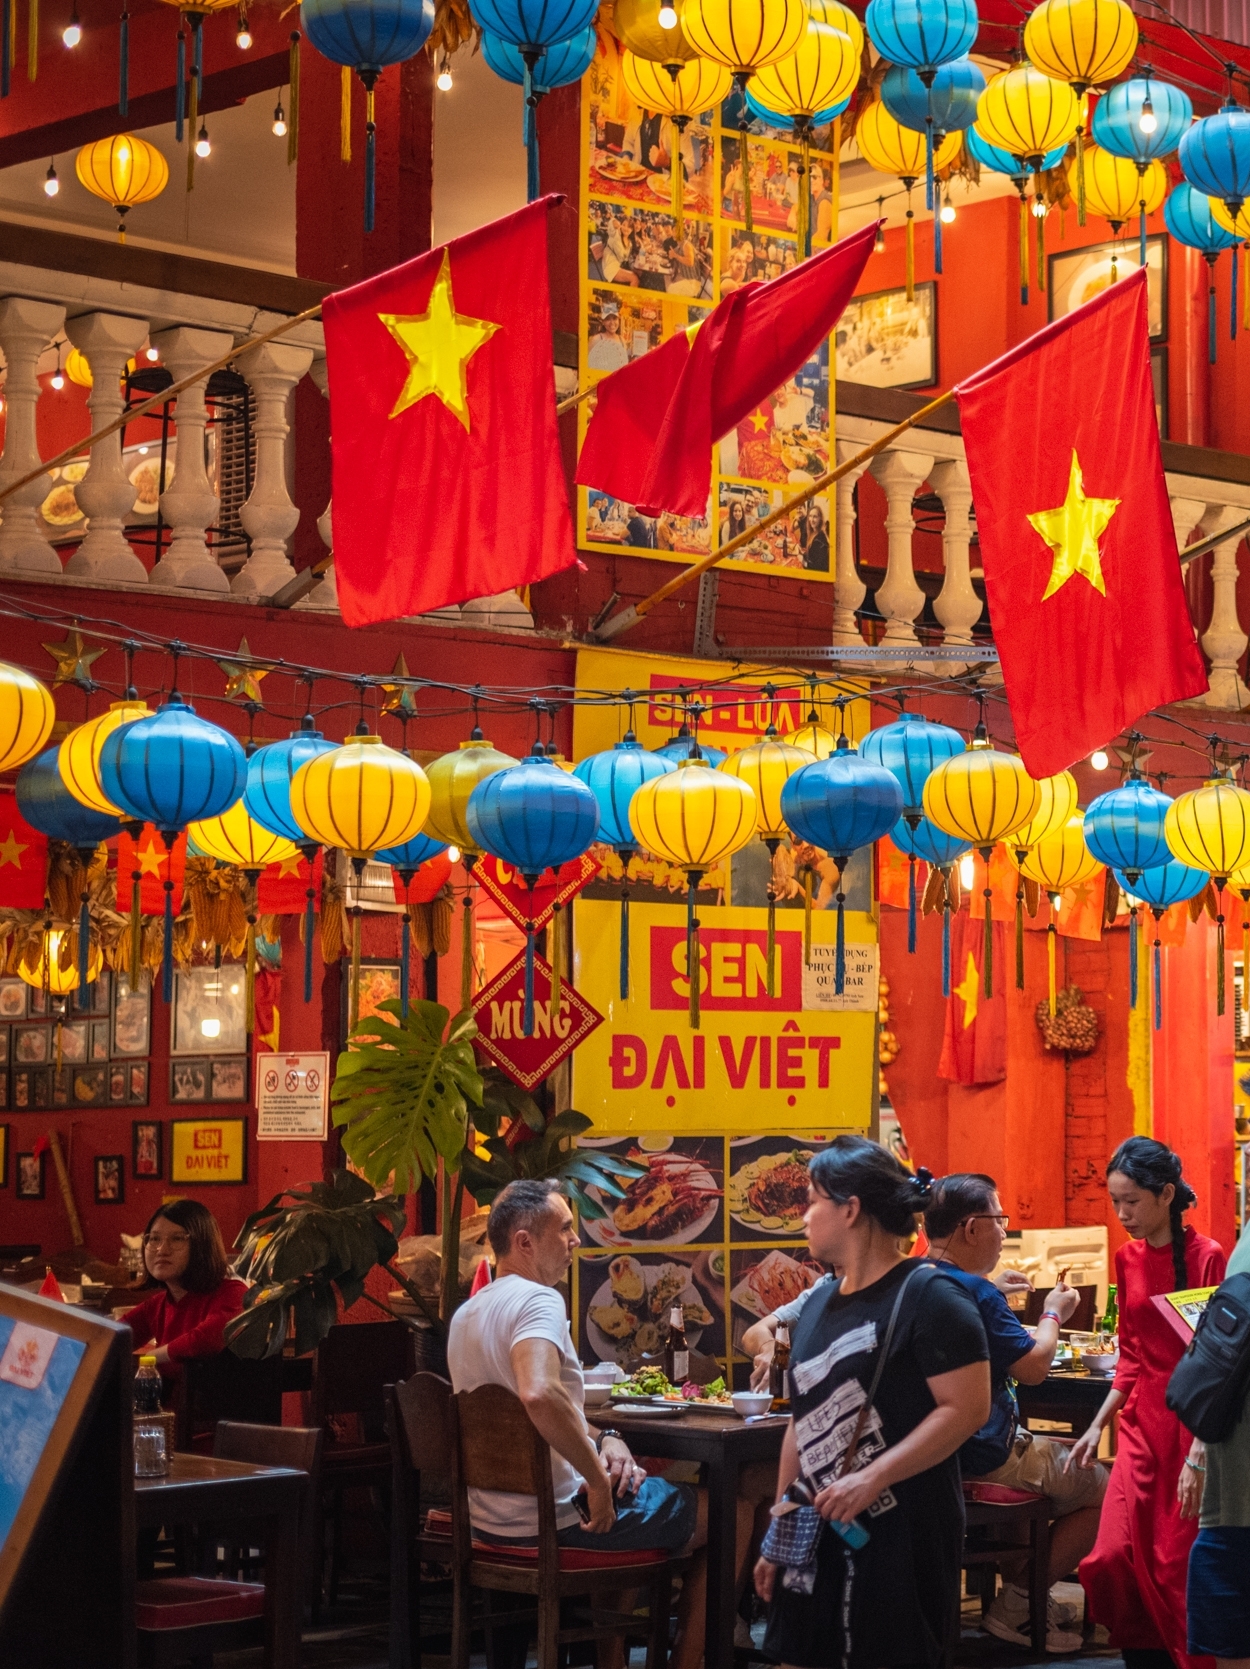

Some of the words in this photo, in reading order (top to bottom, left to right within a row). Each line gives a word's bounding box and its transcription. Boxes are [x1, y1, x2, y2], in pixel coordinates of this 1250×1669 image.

[671, 940, 782, 998] SEN
[845, 976, 864, 986] BAR
[608, 1034, 706, 1108] ĐẠI
[717, 1019, 842, 1107] VIỆT
[197, 1131, 220, 1147] SEN
